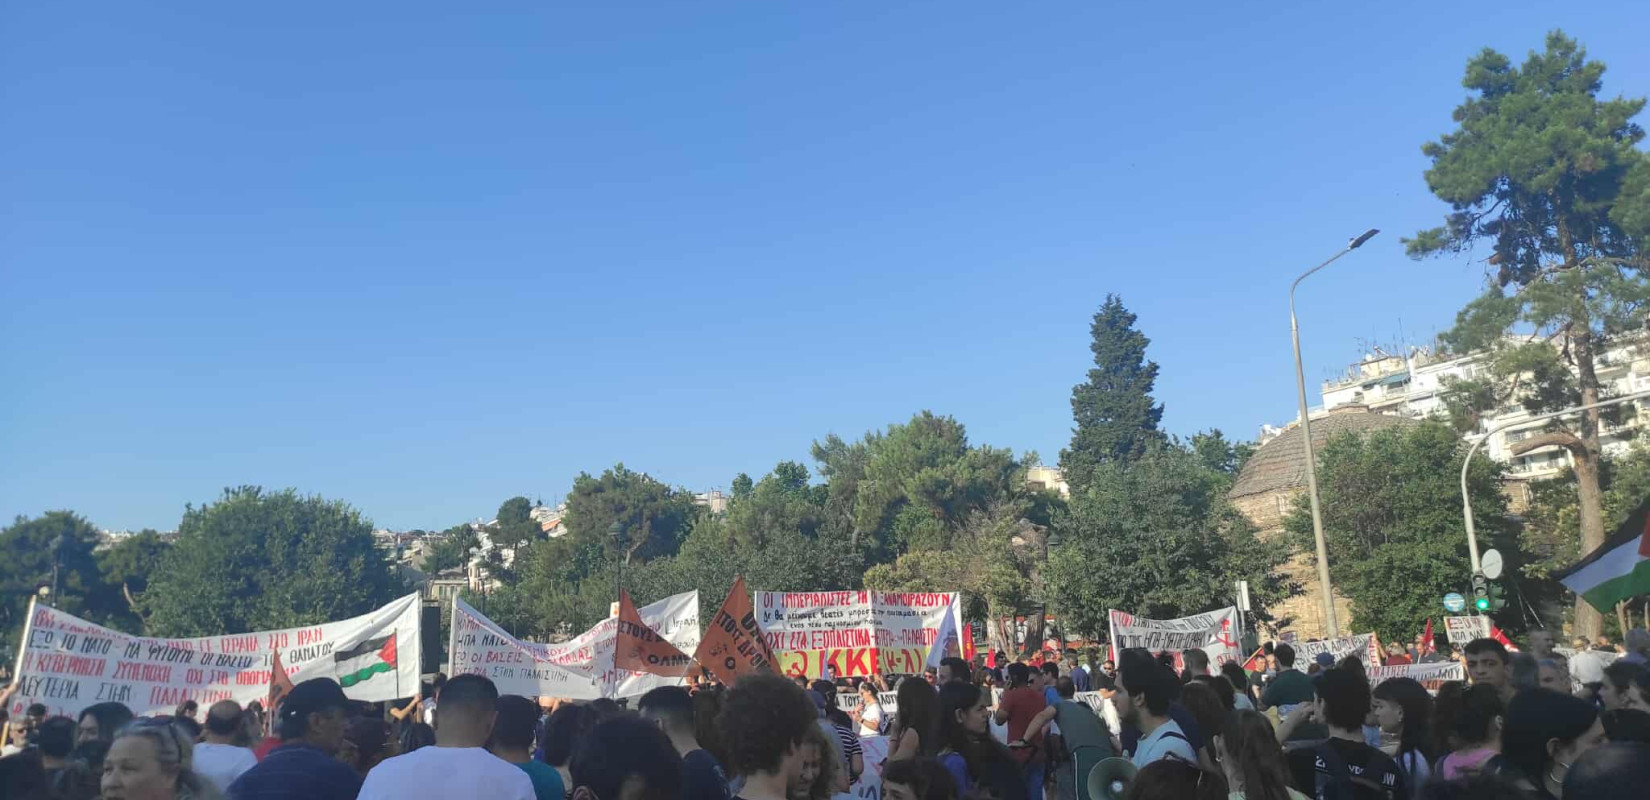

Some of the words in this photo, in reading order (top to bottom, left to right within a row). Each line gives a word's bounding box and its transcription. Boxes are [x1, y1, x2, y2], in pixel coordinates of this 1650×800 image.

[763, 592, 774, 608] ΟΙ
[781, 591, 851, 608] ΙΜΠΕΡΙΑΛΙΣΤΕΣ
[775, 609, 784, 621] θα
[297, 627, 322, 646] ΙΡΑΝ
[766, 631, 785, 650] ΟΧΙ
[790, 631, 808, 650] ΣΤΑ
[80, 636, 112, 655] ΝΑΤΟ
[123, 641, 141, 659] ΝΑ
[290, 641, 335, 664] ΘΑΝΑΤΟΥ
[471, 653, 482, 664] ΟΙ
[486, 651, 523, 664] ΒΑΣΕΙΣ
[819, 647, 880, 678] ΚΚΕ
[186, 667, 203, 683] ΟΧΙ
[209, 668, 229, 684] ΣΤΟ
[492, 666, 514, 678] ΣΤΗΝ
[95, 681, 132, 702] ΣΤΗΝ
